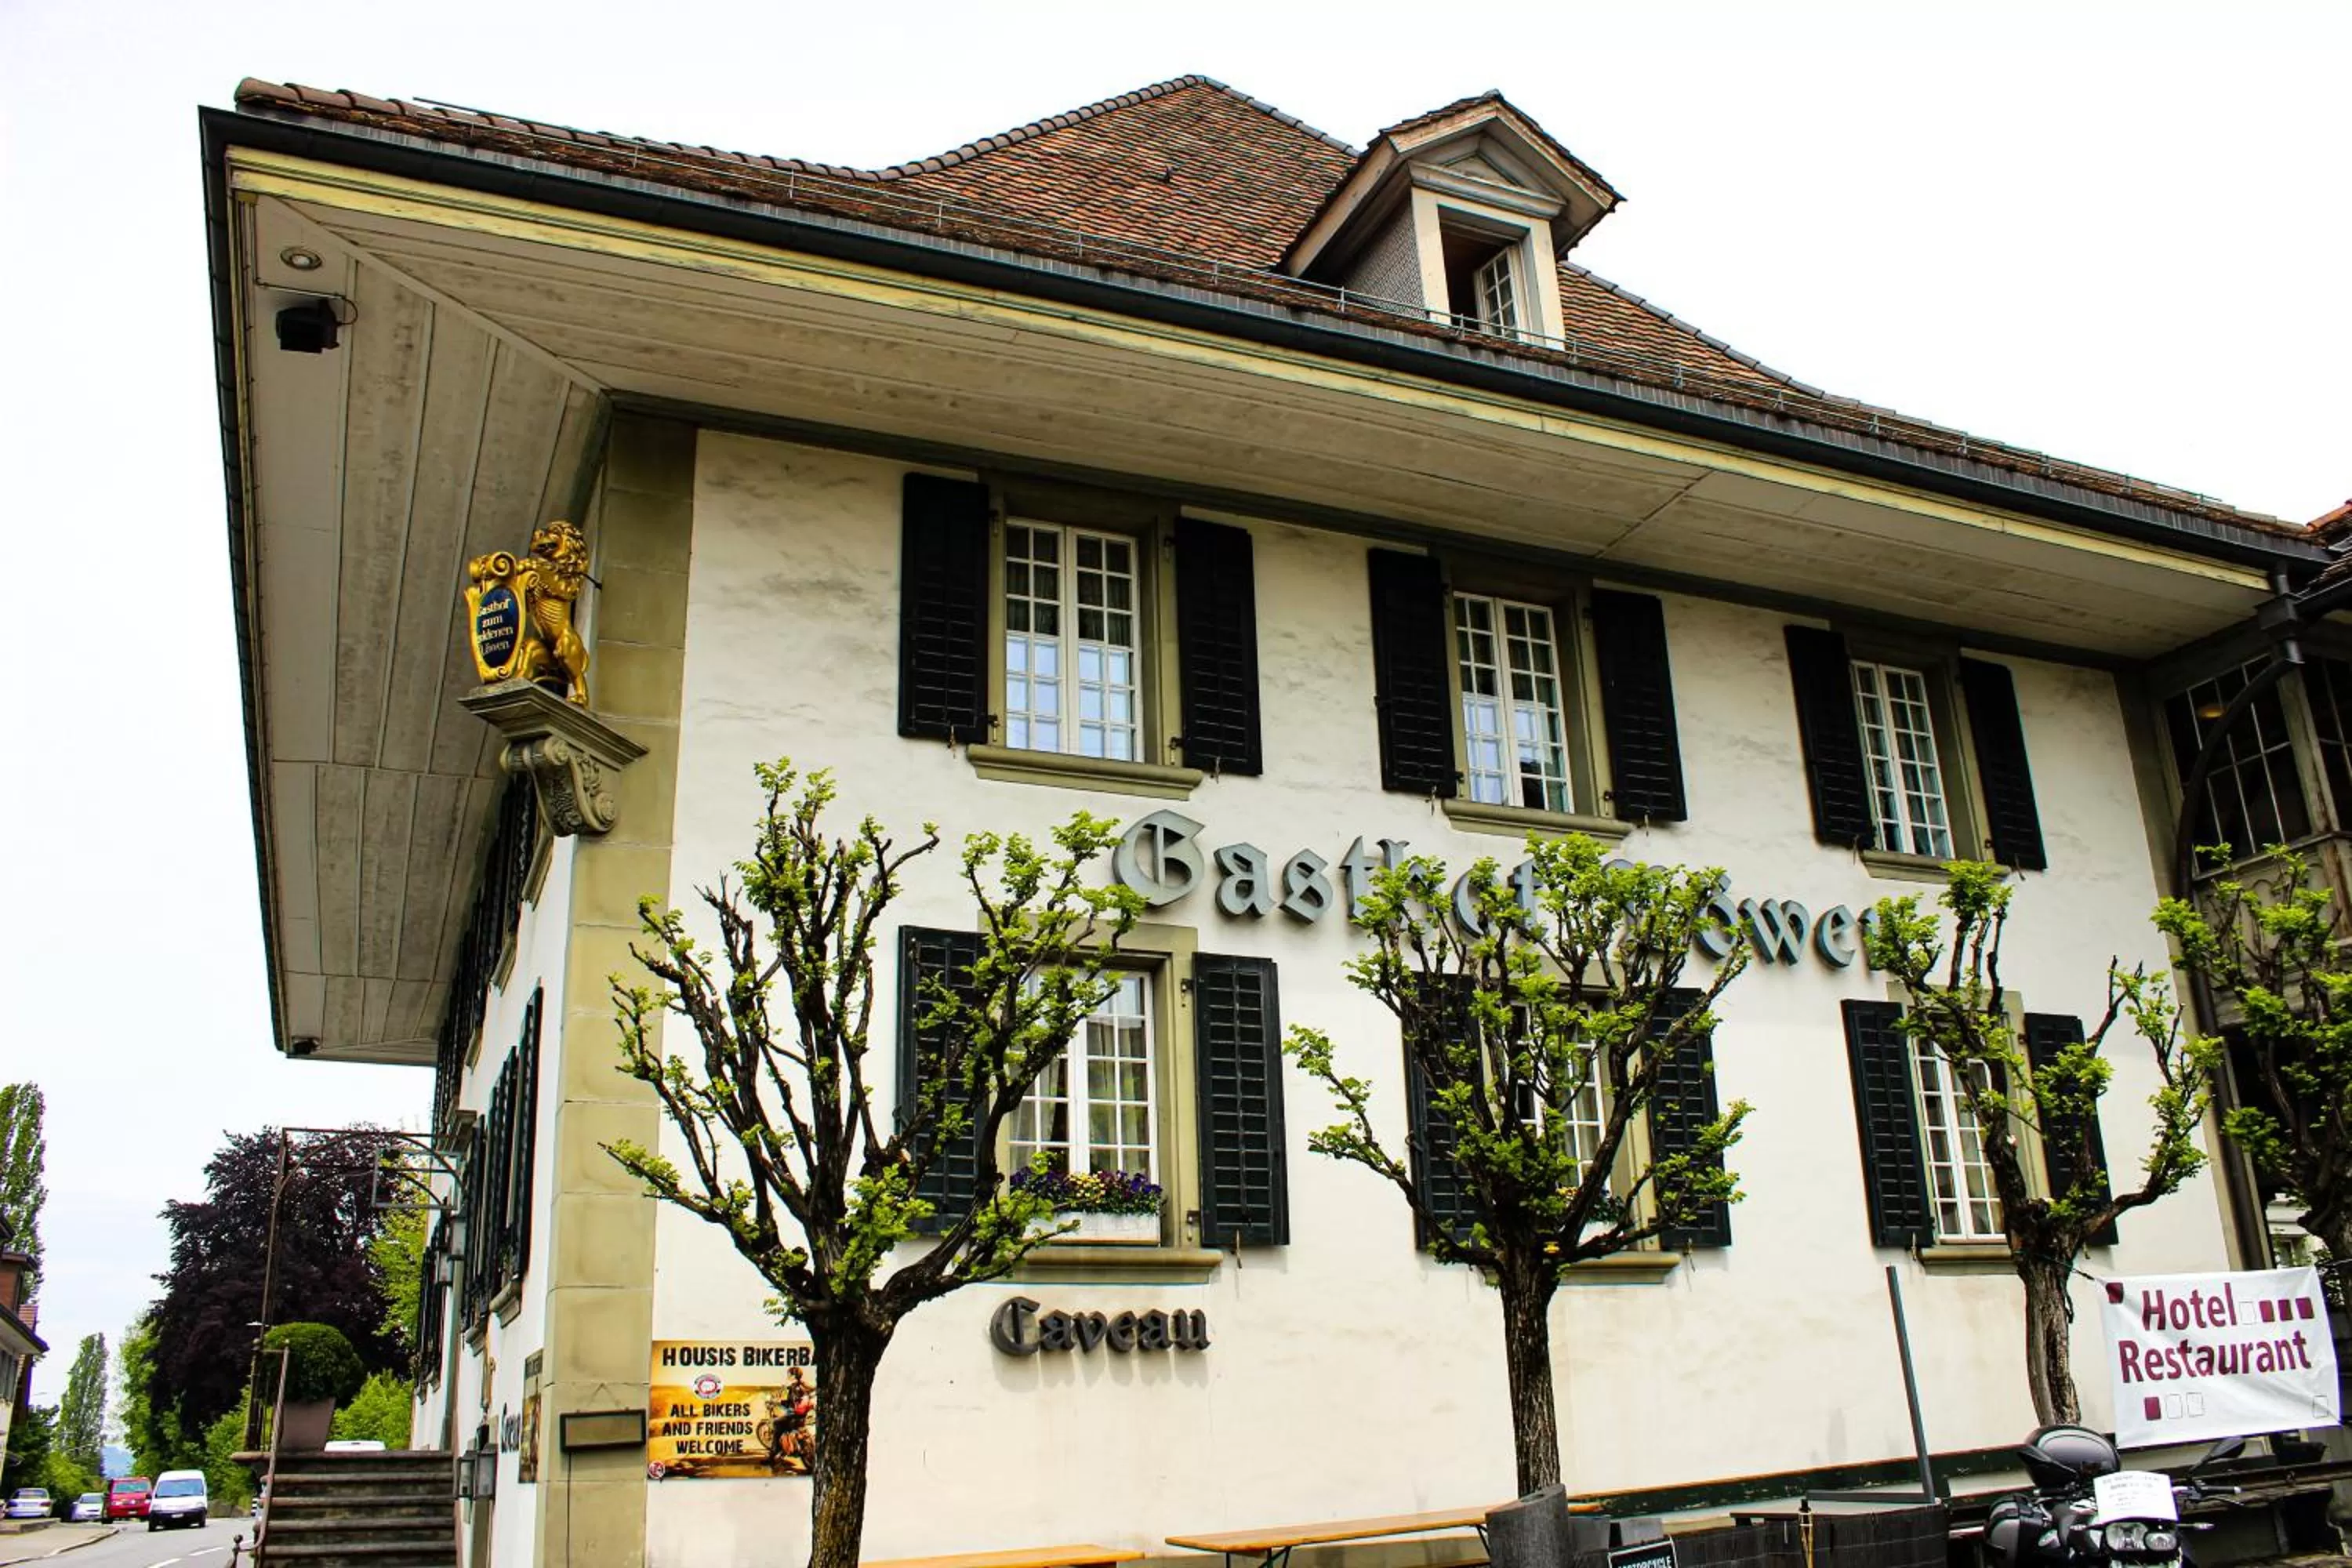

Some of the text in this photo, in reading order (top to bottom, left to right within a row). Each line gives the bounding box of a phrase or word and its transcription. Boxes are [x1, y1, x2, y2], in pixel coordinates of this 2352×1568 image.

[482, 615, 503, 627] zum
[477, 627, 513, 643] ldenen
[1601, 858, 1899, 971] öwe
[2141, 1282, 2237, 1331] Hotel
[990, 1296, 1210, 1356] Caveau
[662, 1345, 816, 1367] HOUSIS BIKERB
[2118, 1330, 2312, 1384] Restaurant
[670, 1403, 750, 1417] ALL BIKERS
[662, 1421, 753, 1436] AND FRIENDS
[676, 1439, 744, 1455] WELCOME
[1617, 1555, 1672, 1568] RCYCLE
